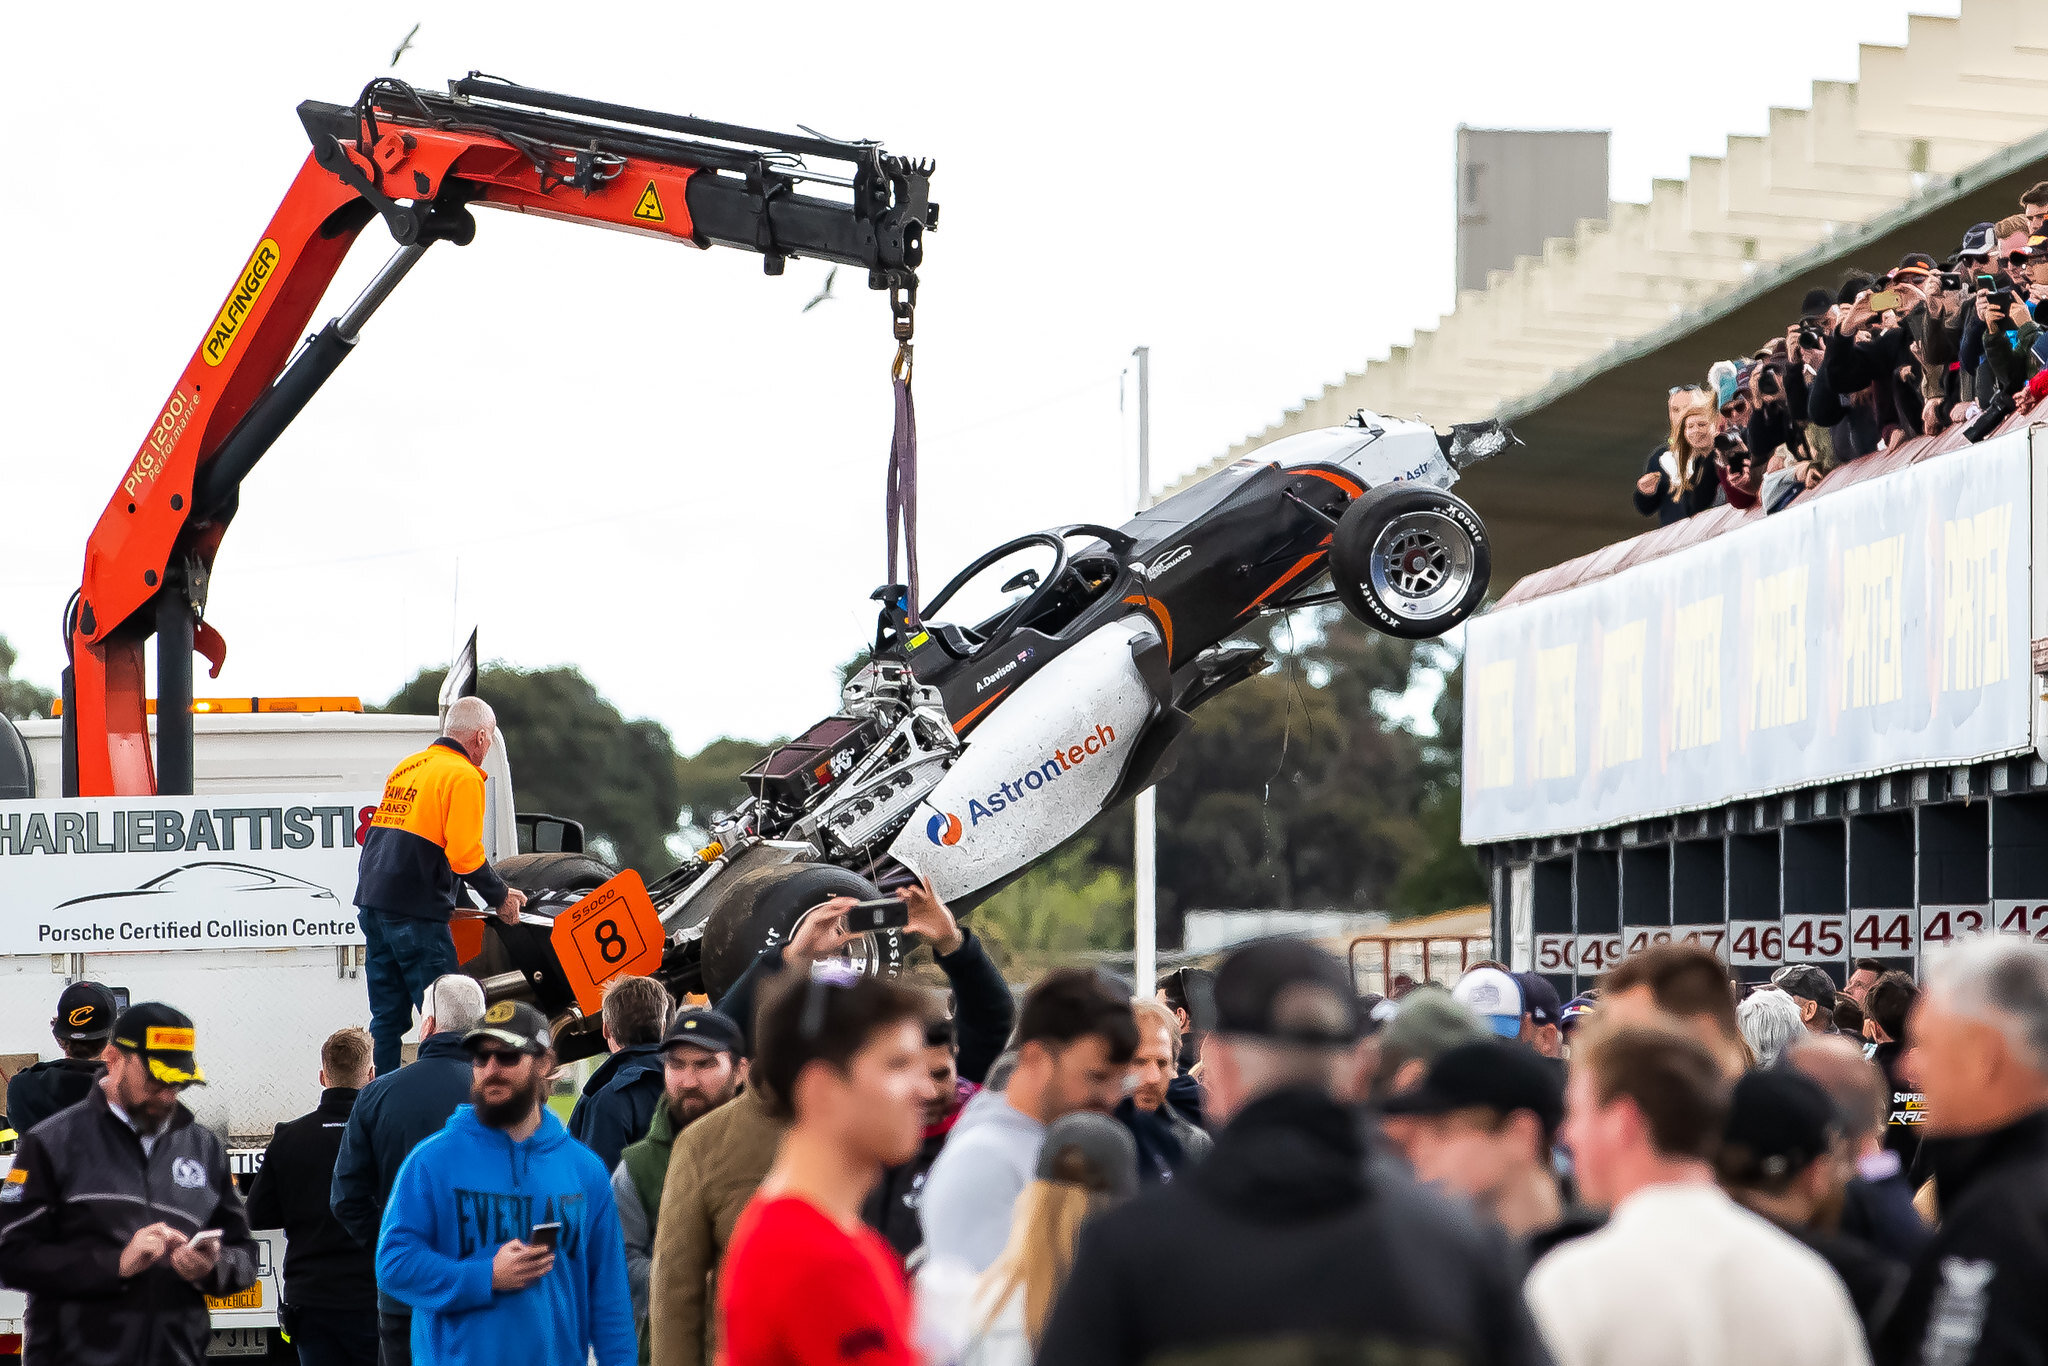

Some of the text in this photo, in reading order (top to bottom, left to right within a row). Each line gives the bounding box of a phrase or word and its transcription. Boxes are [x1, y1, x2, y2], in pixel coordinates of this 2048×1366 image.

[207, 246, 276, 360] PALFINGER
[148, 393, 200, 482] Performance
[124, 450, 154, 497] PKG
[975, 660, 1018, 693] A.Davison
[968, 723, 1116, 826] Astrontech
[379, 802, 407, 814] RANES
[384, 785, 418, 803] RAWLER
[0, 805, 378, 856] HARLIEBATTISTI&
[571, 888, 616, 924] S5000
[38, 917, 356, 942] Porsche Certified Collision Centre
[595, 919, 627, 964] 8
[1732, 926, 1782, 961] 46
[1787, 920, 1844, 956] 45
[1853, 914, 1914, 951] 44
